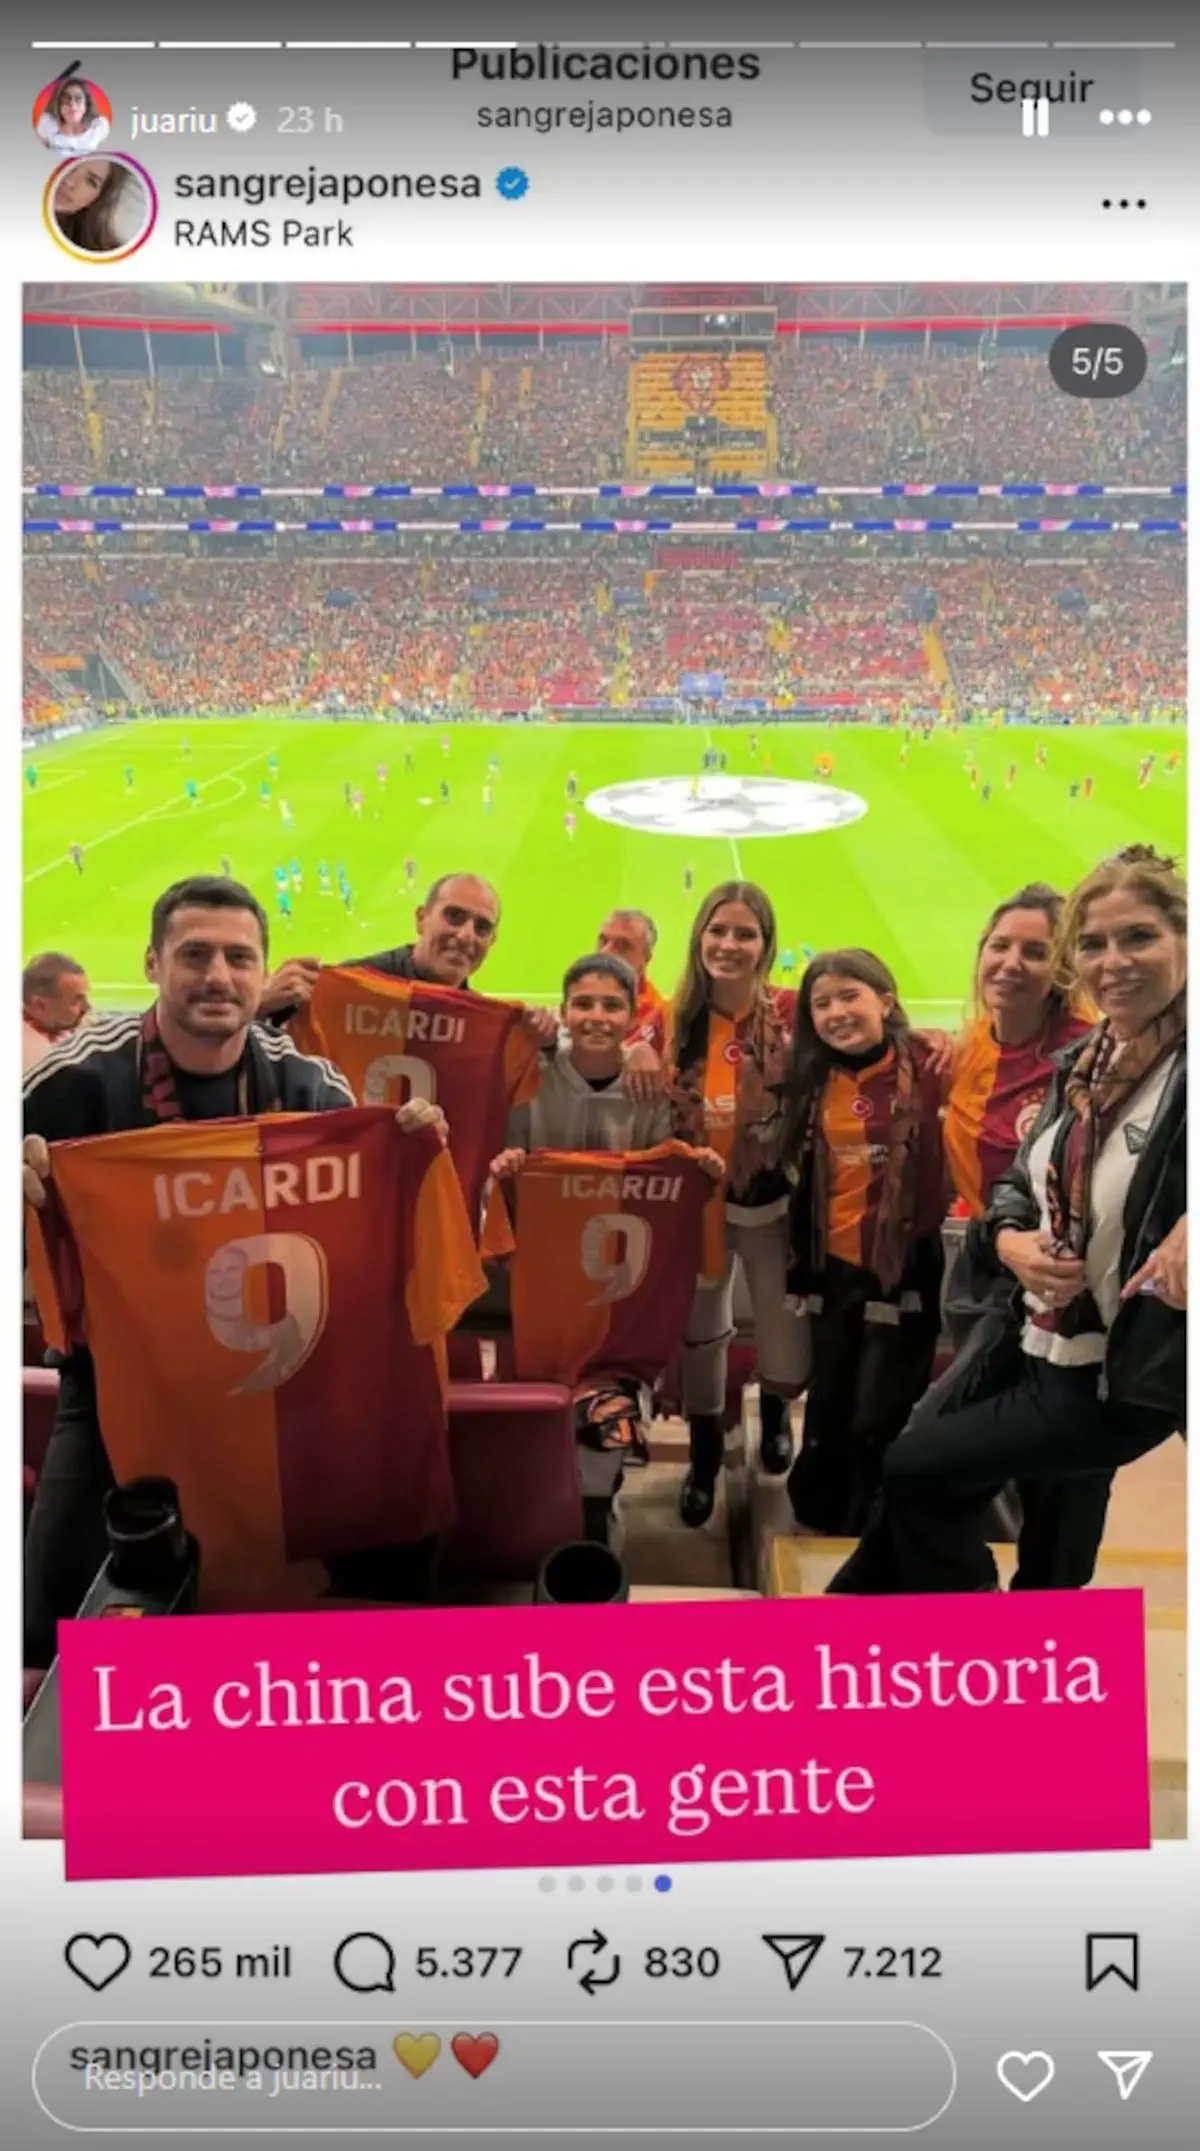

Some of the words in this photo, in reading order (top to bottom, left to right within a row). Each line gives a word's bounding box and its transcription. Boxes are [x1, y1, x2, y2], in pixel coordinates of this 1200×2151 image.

[345, 1003, 465, 1043] ICARDI
[154, 1153, 361, 1221] ICARDI
[562, 1174, 684, 1202] ICARDI
[581, 1213, 653, 1306] 9
[205, 1231, 330, 1396] 9
